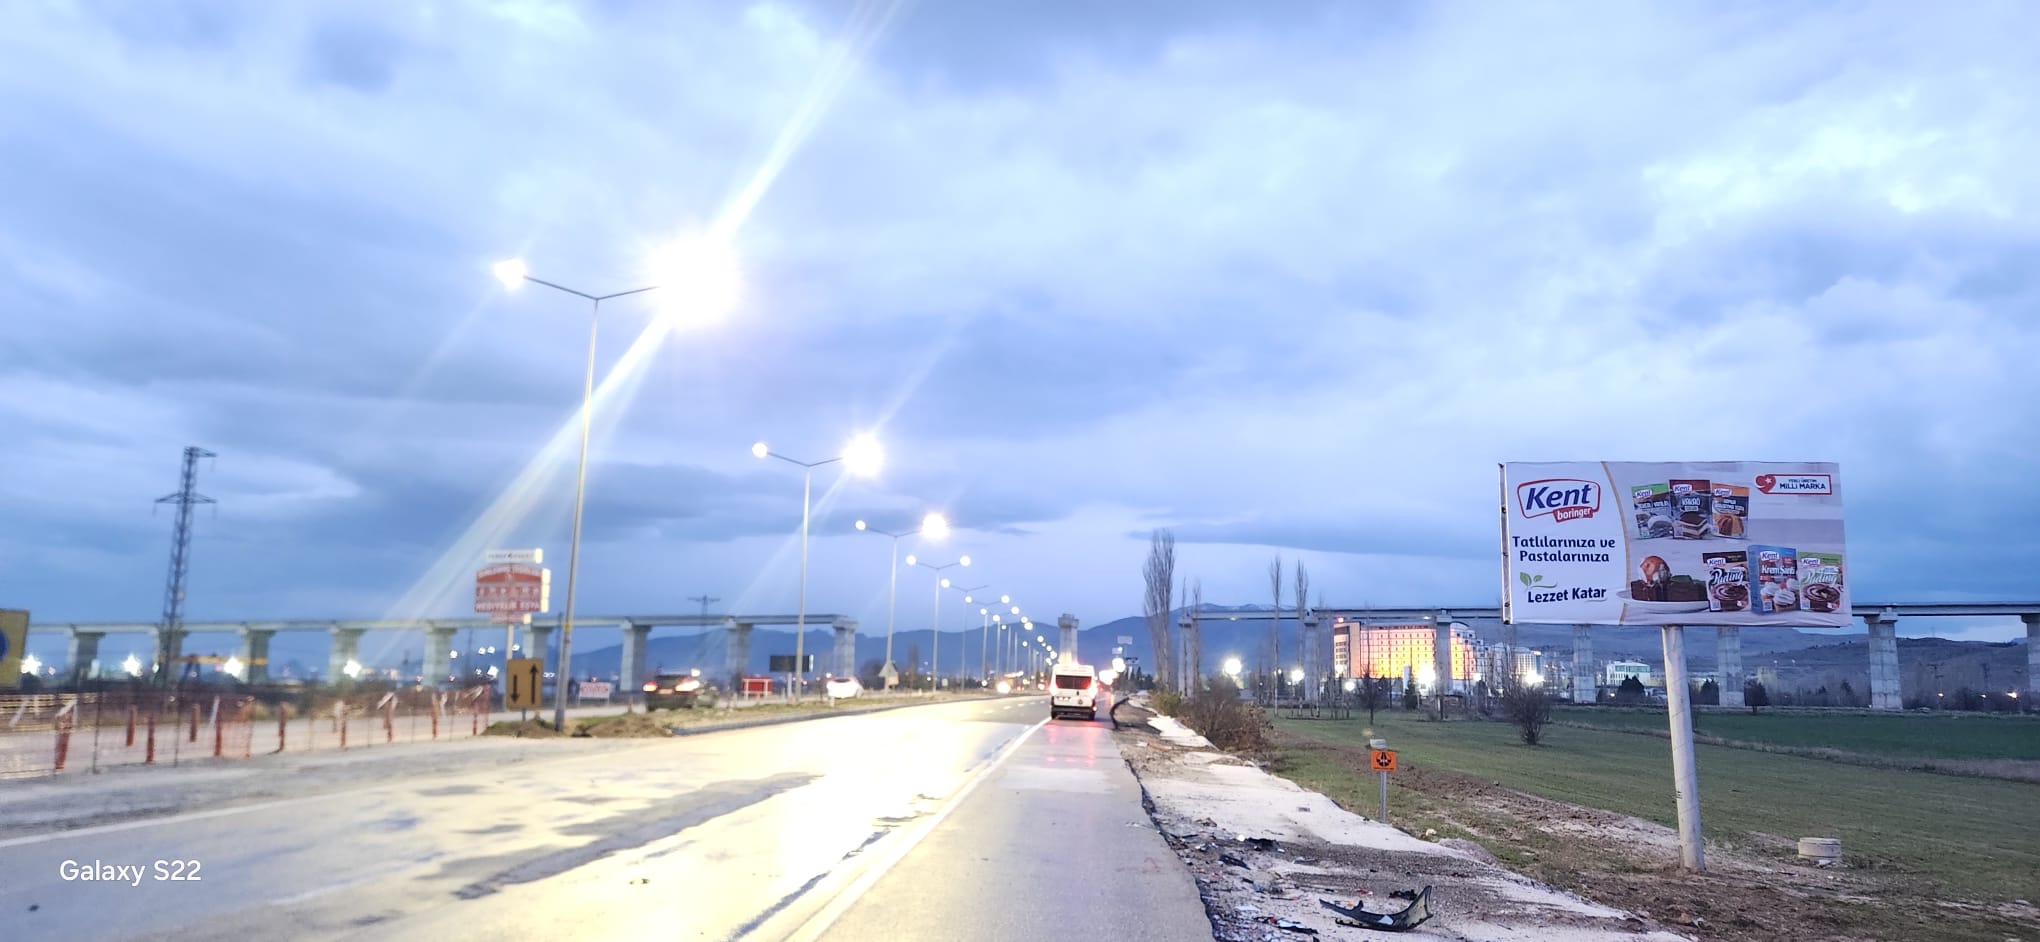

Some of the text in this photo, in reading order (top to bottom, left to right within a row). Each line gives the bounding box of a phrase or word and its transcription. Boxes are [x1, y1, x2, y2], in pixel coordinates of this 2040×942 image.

[1525, 484, 1592, 510] Kent
[1557, 507, 1591, 520] boringer
[1512, 535, 1616, 548] Tatlılarınıza ve
[1519, 550, 1610, 562] Pastalarınıza
[1527, 587, 1607, 603] Lezzet Katar
